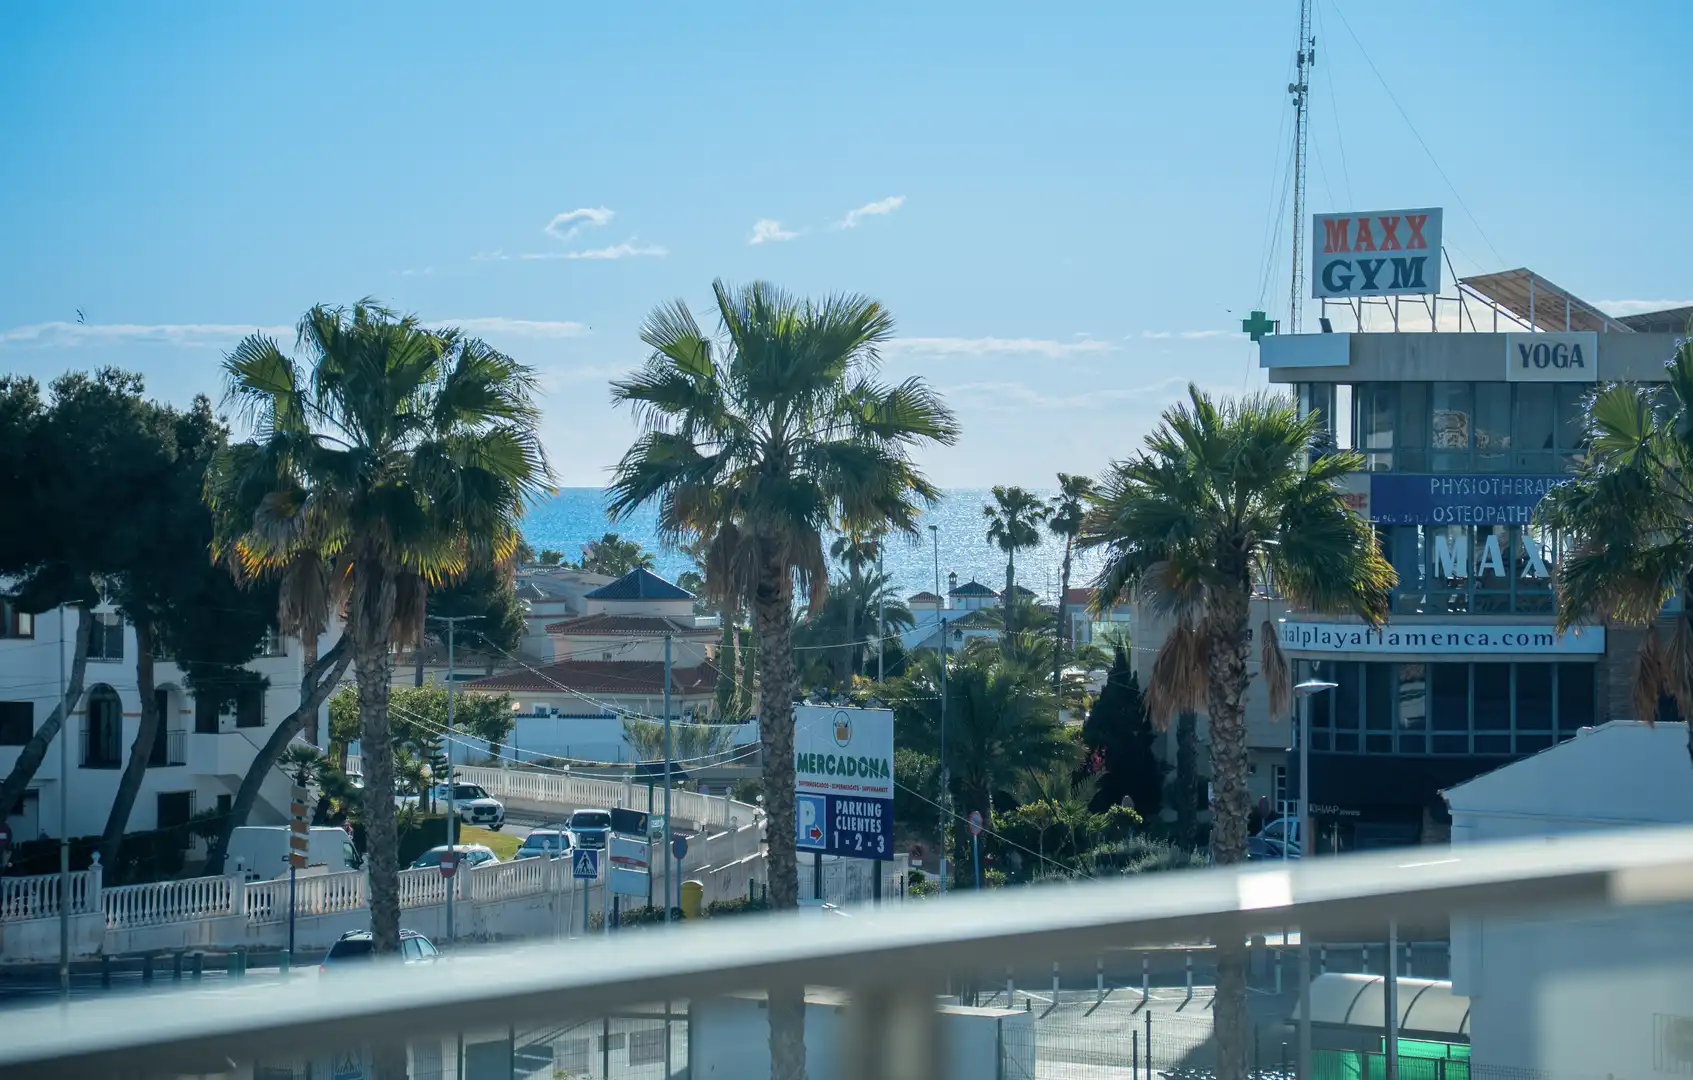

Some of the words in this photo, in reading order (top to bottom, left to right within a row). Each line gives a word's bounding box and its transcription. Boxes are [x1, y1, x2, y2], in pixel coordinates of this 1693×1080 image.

[1323, 215, 1429, 253] MAXX
[1322, 257, 1429, 293] GYM
[1518, 342, 1585, 369] YOGA
[1434, 534, 1573, 578] MAX
[1281, 625, 1554, 648] ialplayaflamenca.com
[796, 753, 890, 780] MERCADONA
[799, 800, 816, 840] P
[836, 800, 882, 818] PARKING
[835, 816, 882, 833] CLIENTES
[854, 833, 863, 851] 2
[877, 835, 885, 853] 3
